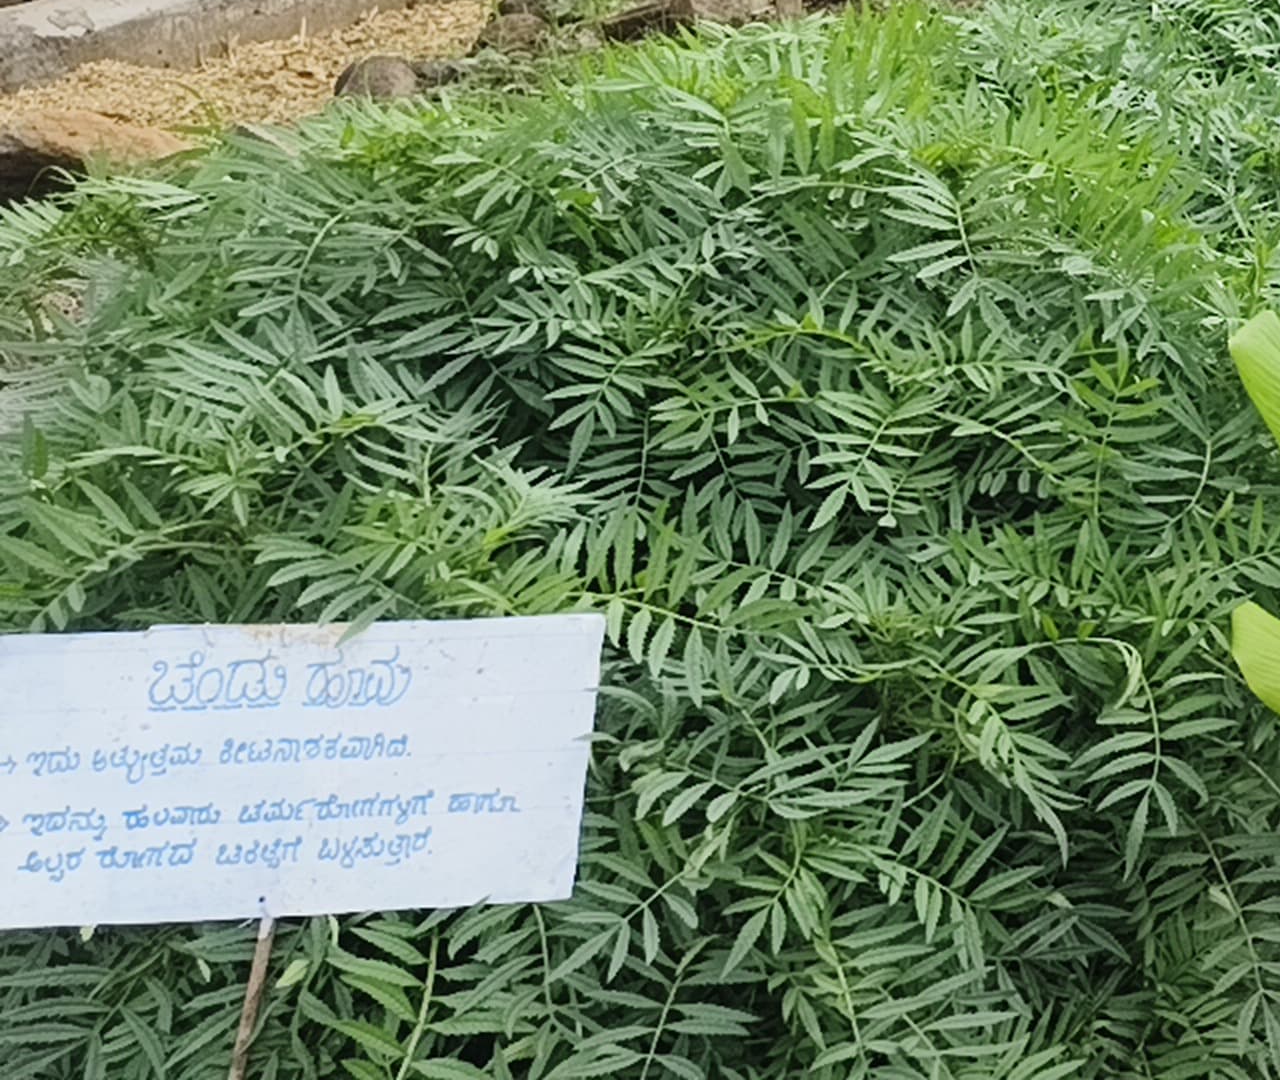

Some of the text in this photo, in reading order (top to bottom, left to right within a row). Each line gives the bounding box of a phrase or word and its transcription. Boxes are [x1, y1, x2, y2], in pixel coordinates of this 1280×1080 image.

[148, 643, 412, 713] ಚೆಂಡು ಹೂವು
[25, 745, 81, 777] ಇದು
[21, 805, 108, 842] ಇದನ್ನು
[121, 802, 222, 831] ಹಲವಾರು
[447, 787, 521, 815] ಹಾಗೂ
